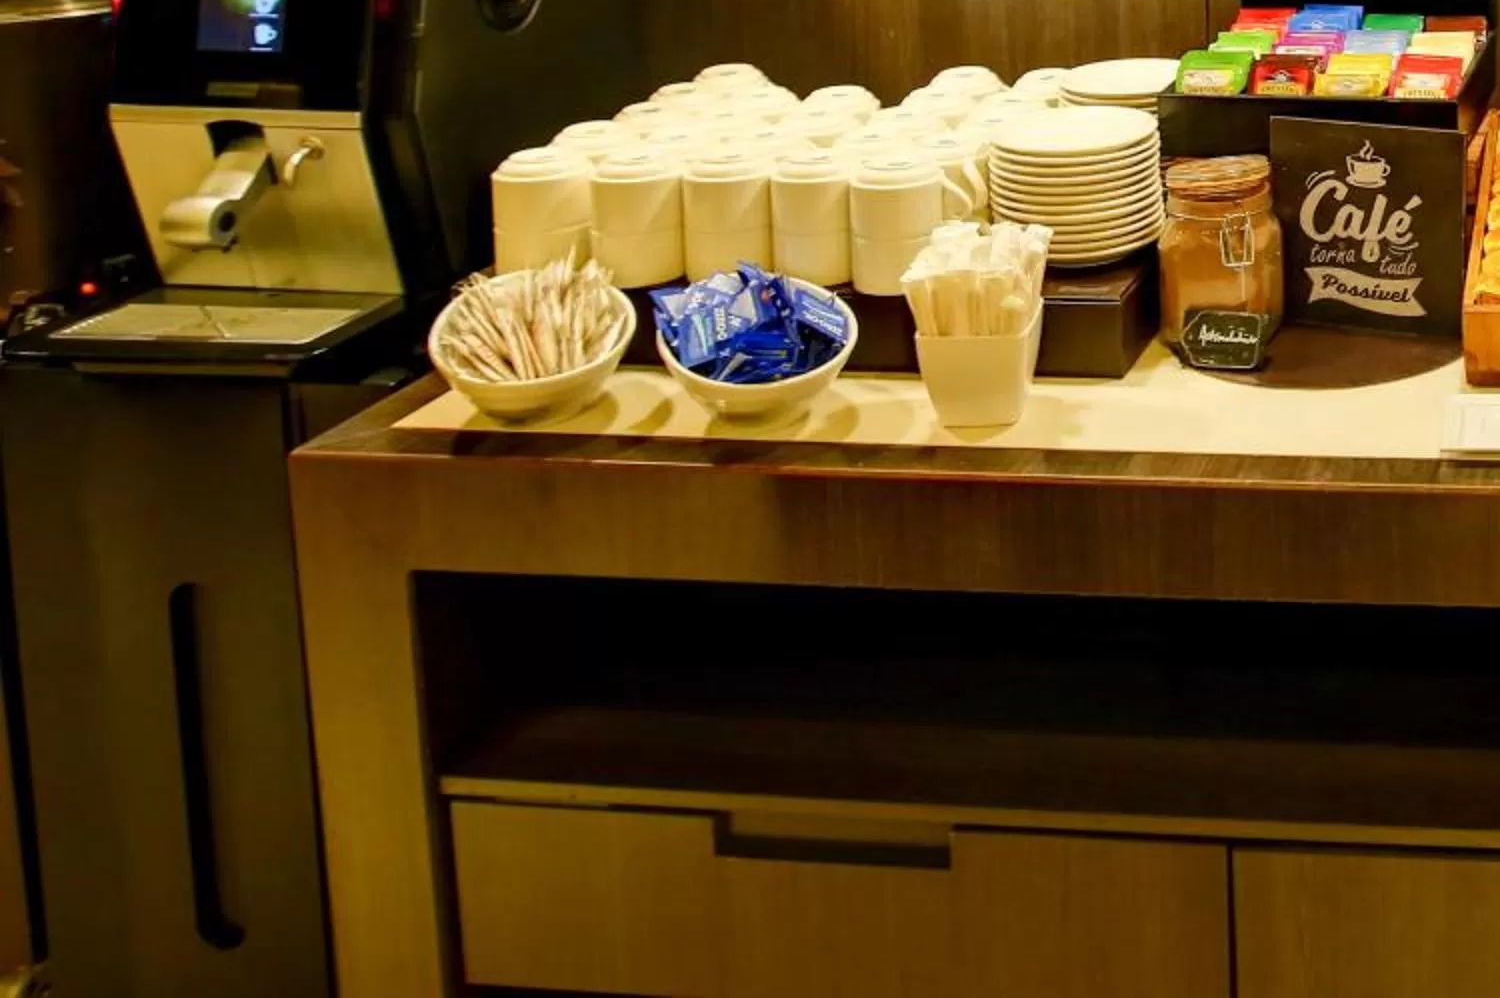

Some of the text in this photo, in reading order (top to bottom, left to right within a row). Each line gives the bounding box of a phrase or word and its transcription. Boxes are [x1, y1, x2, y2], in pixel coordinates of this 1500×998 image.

[1299, 178, 1423, 263] Café
[1310, 243, 1417, 276] torna tudo
[1320, 273, 1411, 303] Possível
